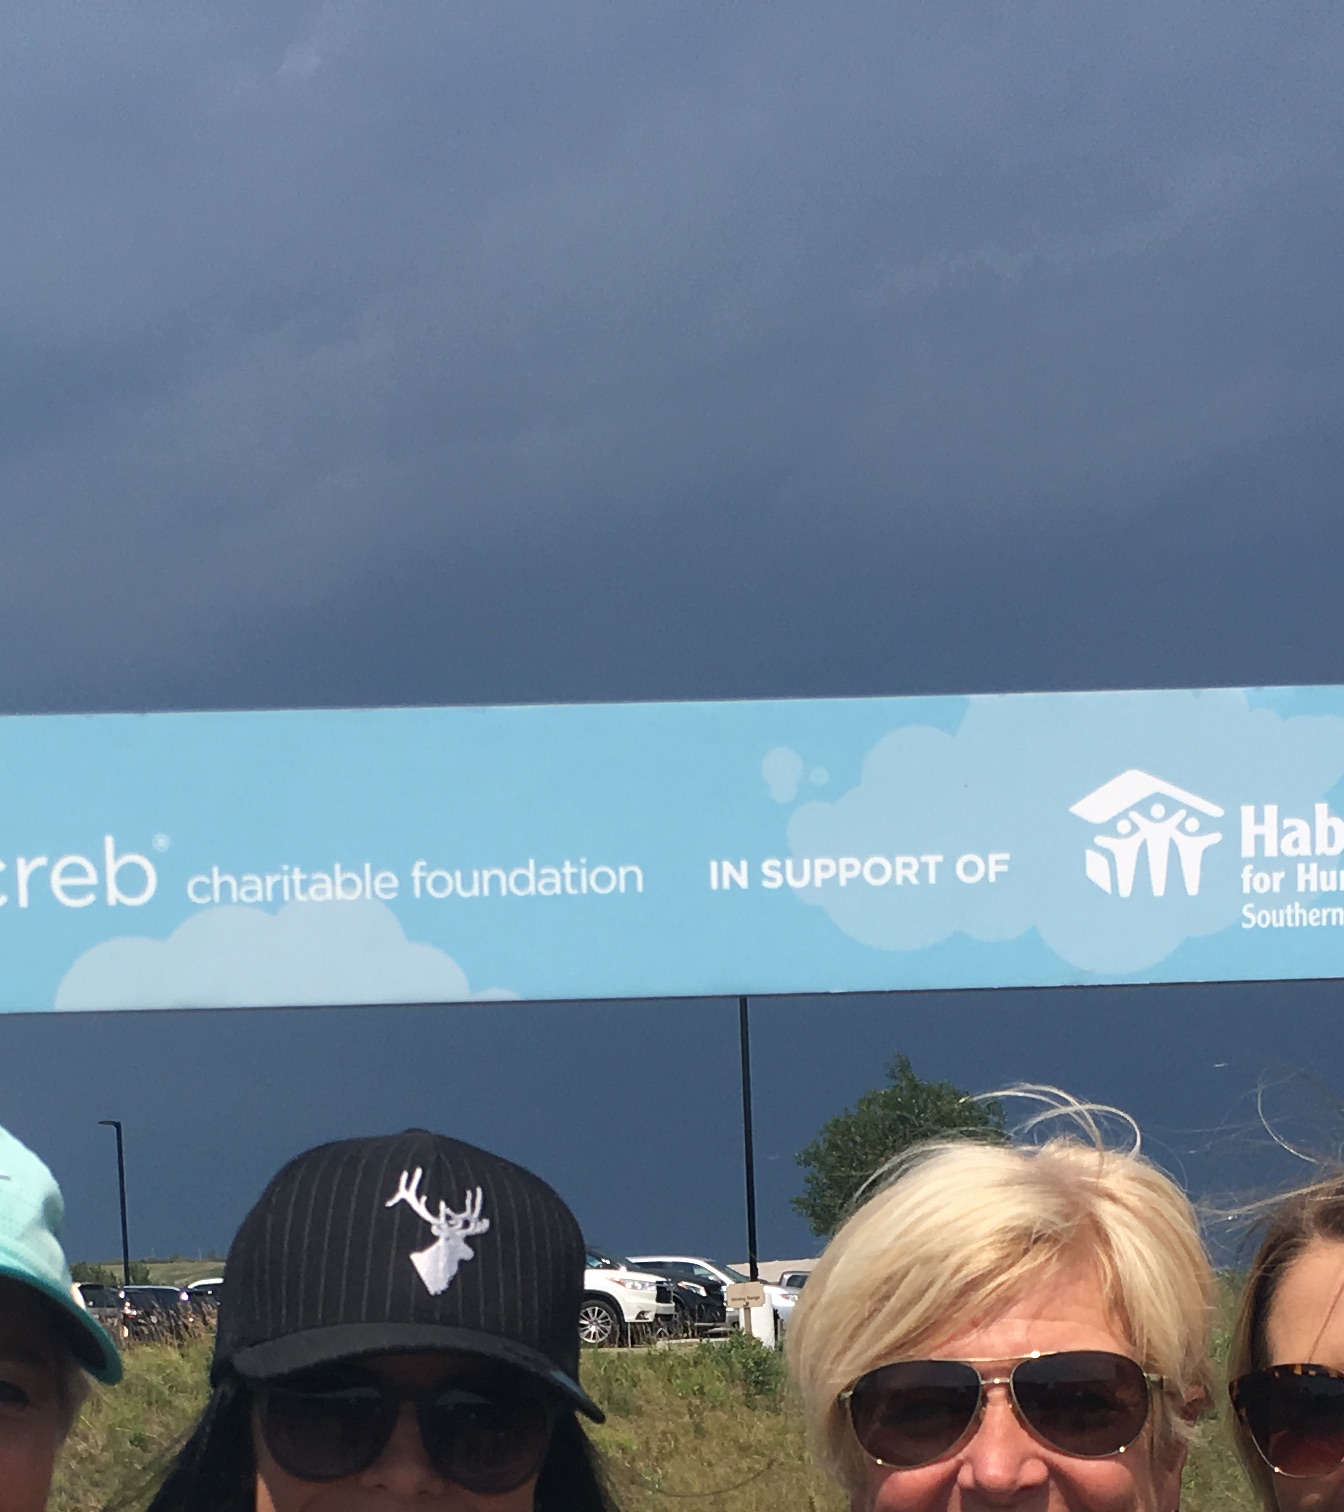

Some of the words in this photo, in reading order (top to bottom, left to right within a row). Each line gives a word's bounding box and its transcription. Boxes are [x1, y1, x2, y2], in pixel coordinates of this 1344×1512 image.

[186, 865, 400, 904] charitable
[411, 858, 645, 899] foundation
[709, 858, 749, 890] IN
[760, 854, 944, 889] SUPPORT
[955, 852, 1011, 884] OF
[1240, 864, 1286, 894] for
